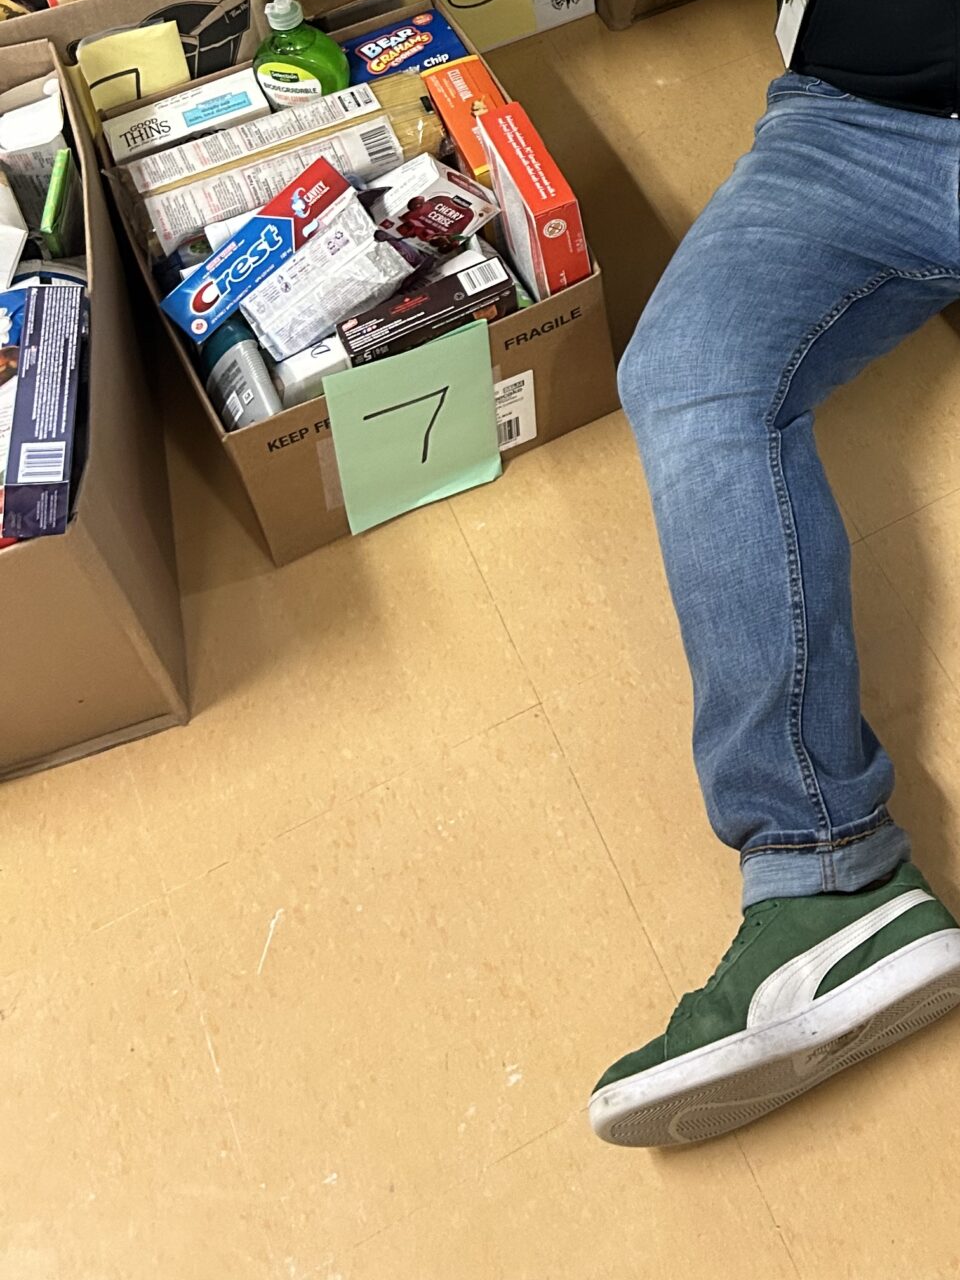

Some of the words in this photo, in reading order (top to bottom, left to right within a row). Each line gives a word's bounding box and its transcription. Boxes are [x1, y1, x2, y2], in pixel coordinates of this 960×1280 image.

[360, 27, 416, 59] BEAR
[369, 34, 432, 72] GRAHAMS
[423, 52, 450, 70] Chip
[263, 82, 319, 95] BIODEGRADABLE
[119, 120, 171, 149] THINS
[131, 118, 158, 132] GOOD
[303, 180, 328, 204] CAVITY
[427, 211, 455, 227] CERISE
[434, 202, 465, 221] CHERRY
[190, 223, 284, 315] Crest
[503, 306, 583, 352] FRAGILE
[363, 385, 450, 464] 7
[267, 426, 310, 454] KEEP
